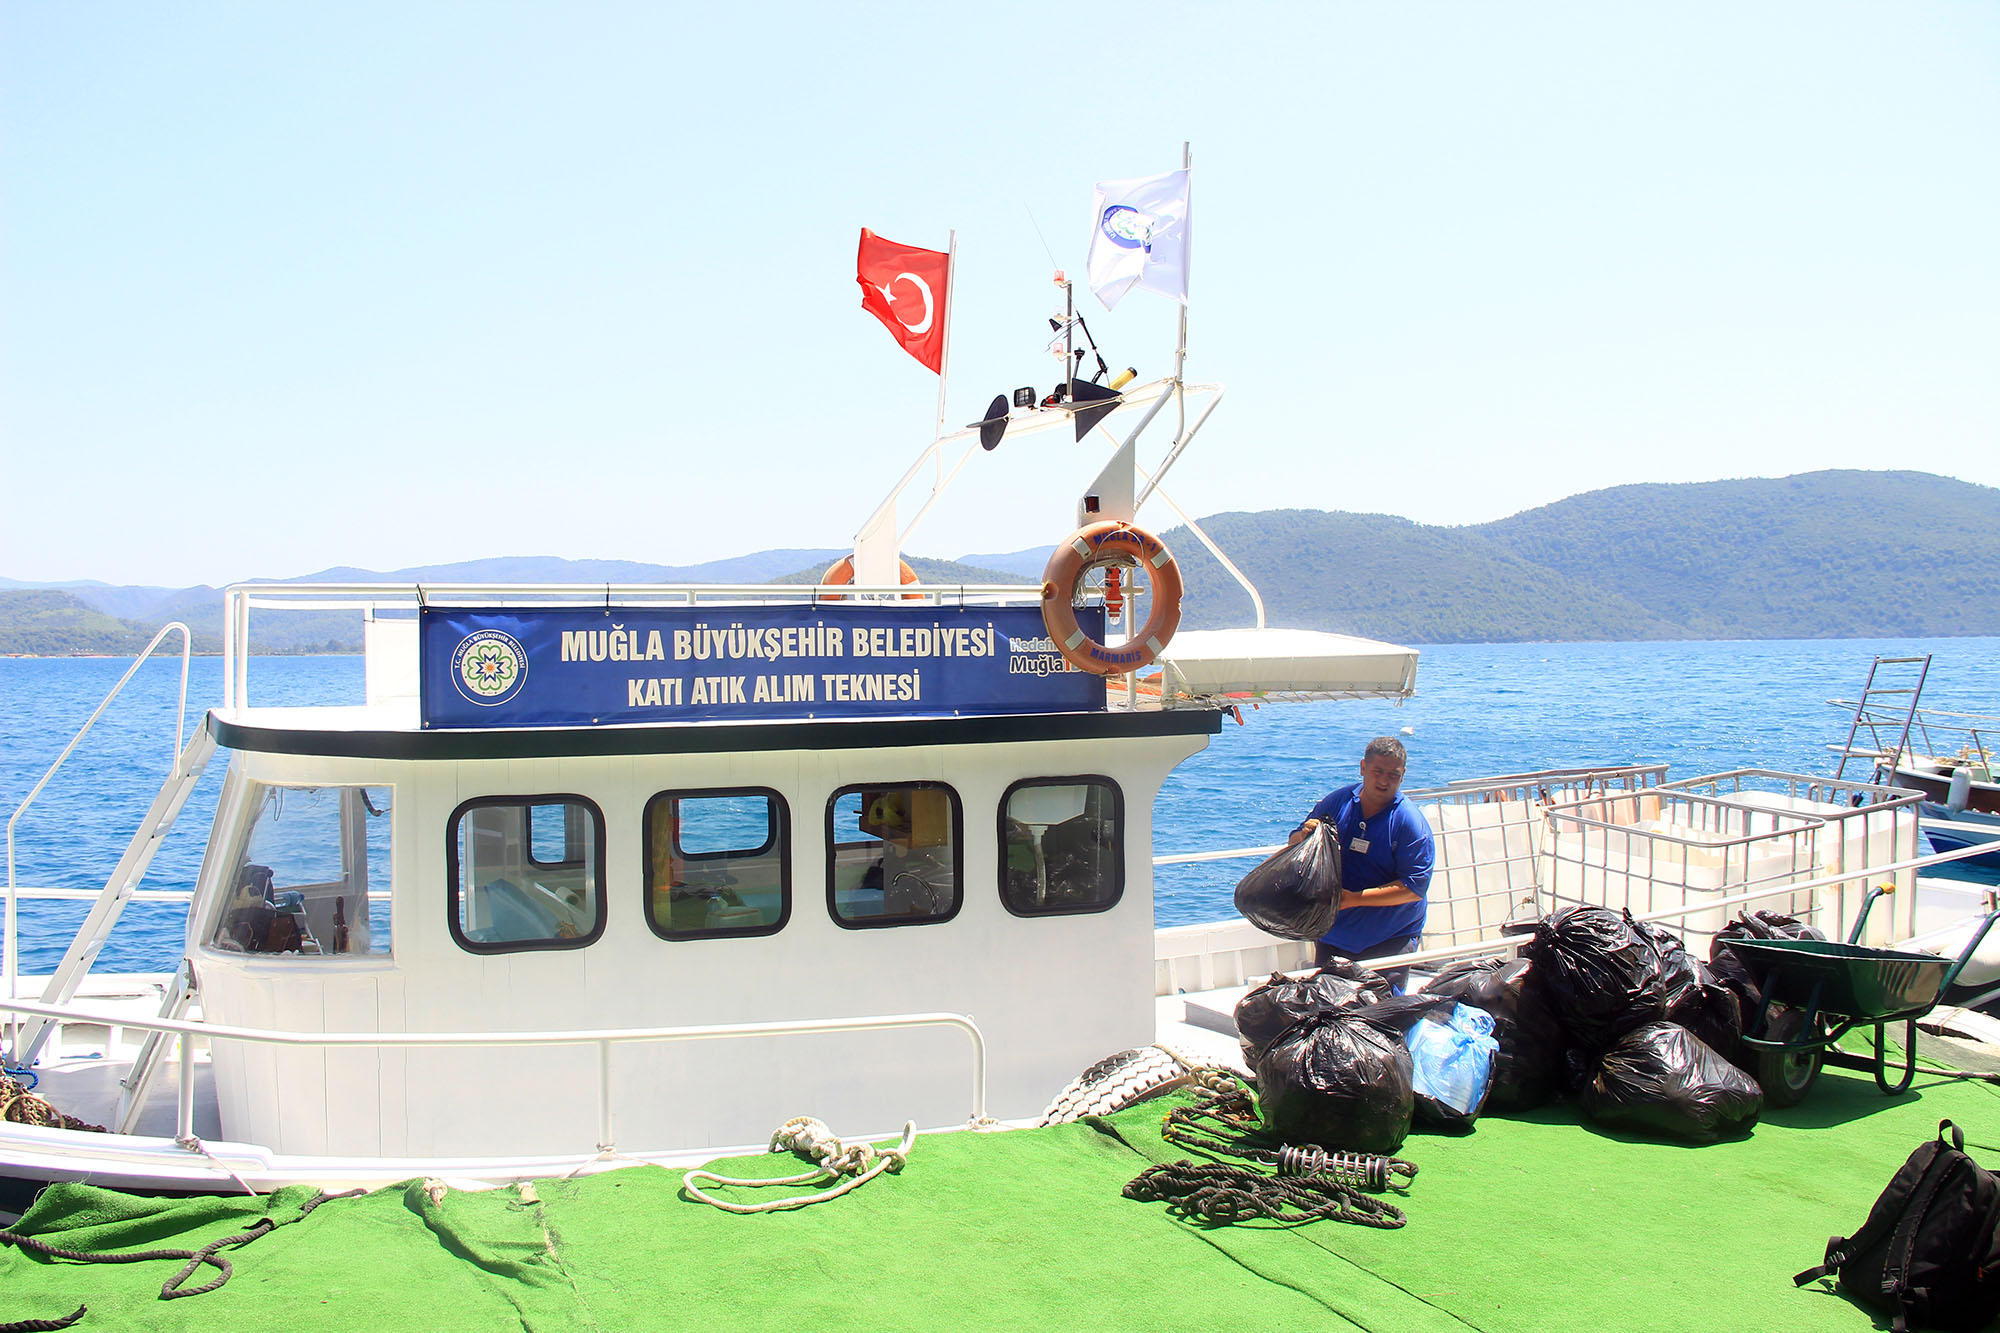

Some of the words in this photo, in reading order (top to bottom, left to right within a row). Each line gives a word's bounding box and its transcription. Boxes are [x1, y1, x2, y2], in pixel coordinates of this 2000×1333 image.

[561, 623, 665, 662] MUĞLA
[673, 621, 843, 662] BÜYÜKŞEHİR
[852, 621, 995, 657] BELEDİYESİ
[1010, 637, 1058, 652] Hedefi
[628, 678, 683, 707] KATI
[691, 676, 746, 705] ATIK
[753, 674, 815, 703] ALIM
[821, 668, 921, 701] TEKNESİ
